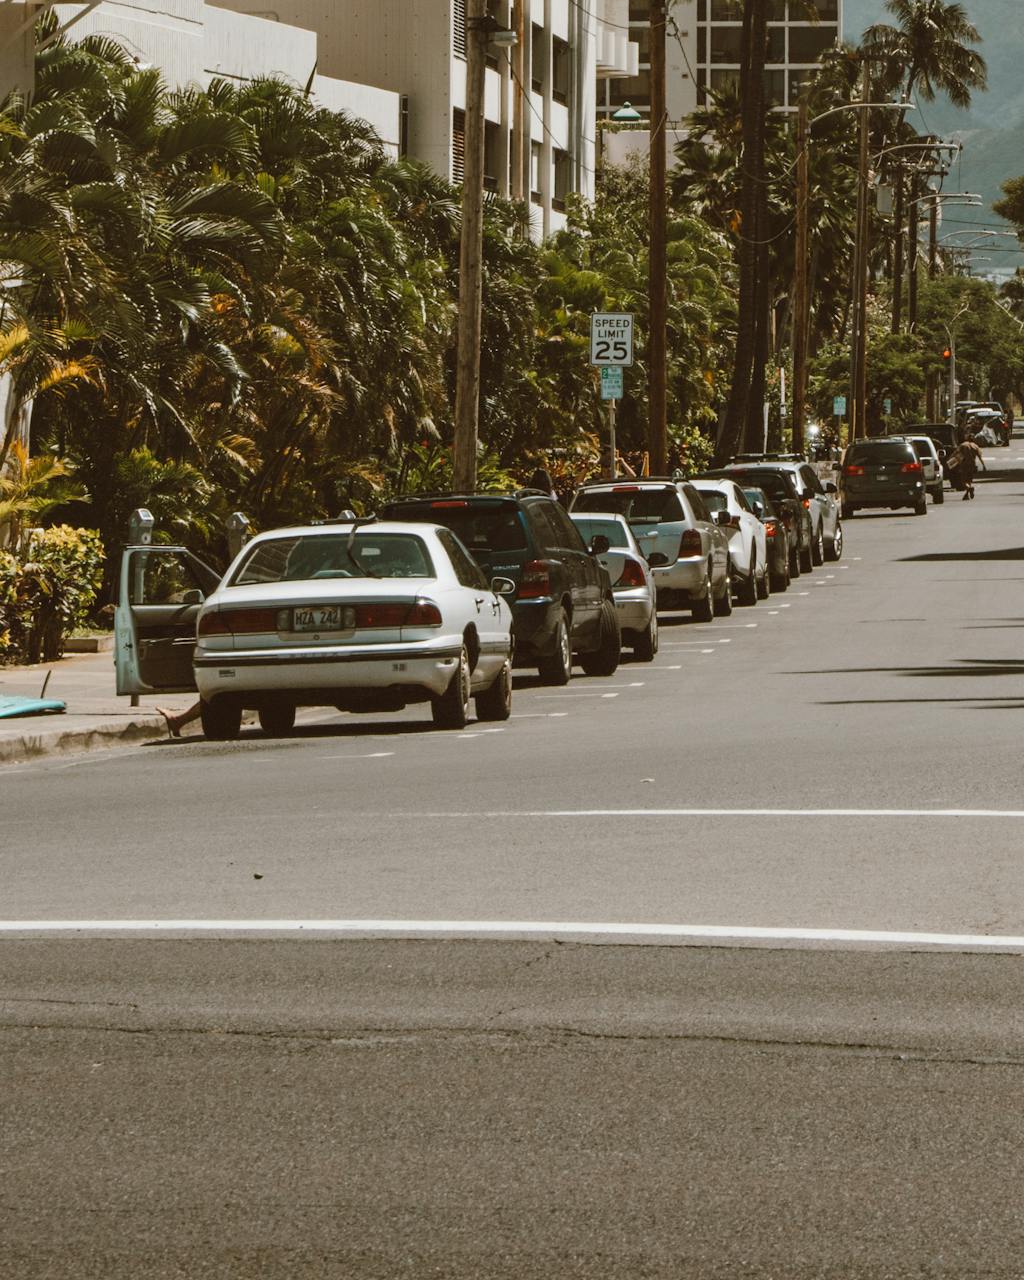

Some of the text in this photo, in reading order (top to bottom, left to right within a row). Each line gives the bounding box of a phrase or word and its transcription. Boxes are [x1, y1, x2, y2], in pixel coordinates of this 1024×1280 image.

[595, 319, 630, 328] SPEED
[598, 330, 625, 338] LIMIT
[595, 341, 628, 360] 25
[295, 610, 338, 625] HZA 242
